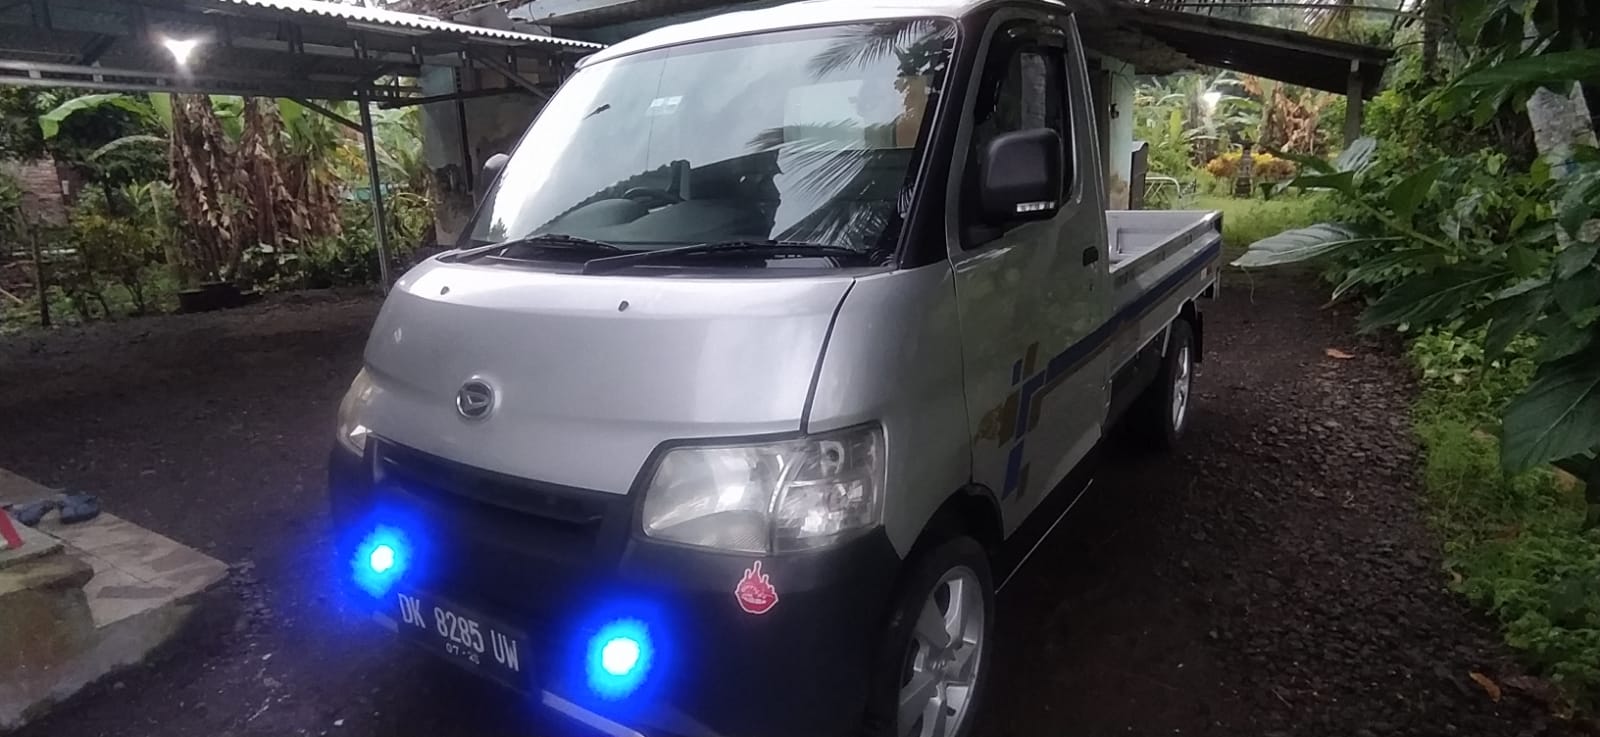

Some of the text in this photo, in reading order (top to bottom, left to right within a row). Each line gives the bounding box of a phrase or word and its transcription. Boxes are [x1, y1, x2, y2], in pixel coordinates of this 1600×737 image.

[398, 593, 519, 671] DK 8285 UW
